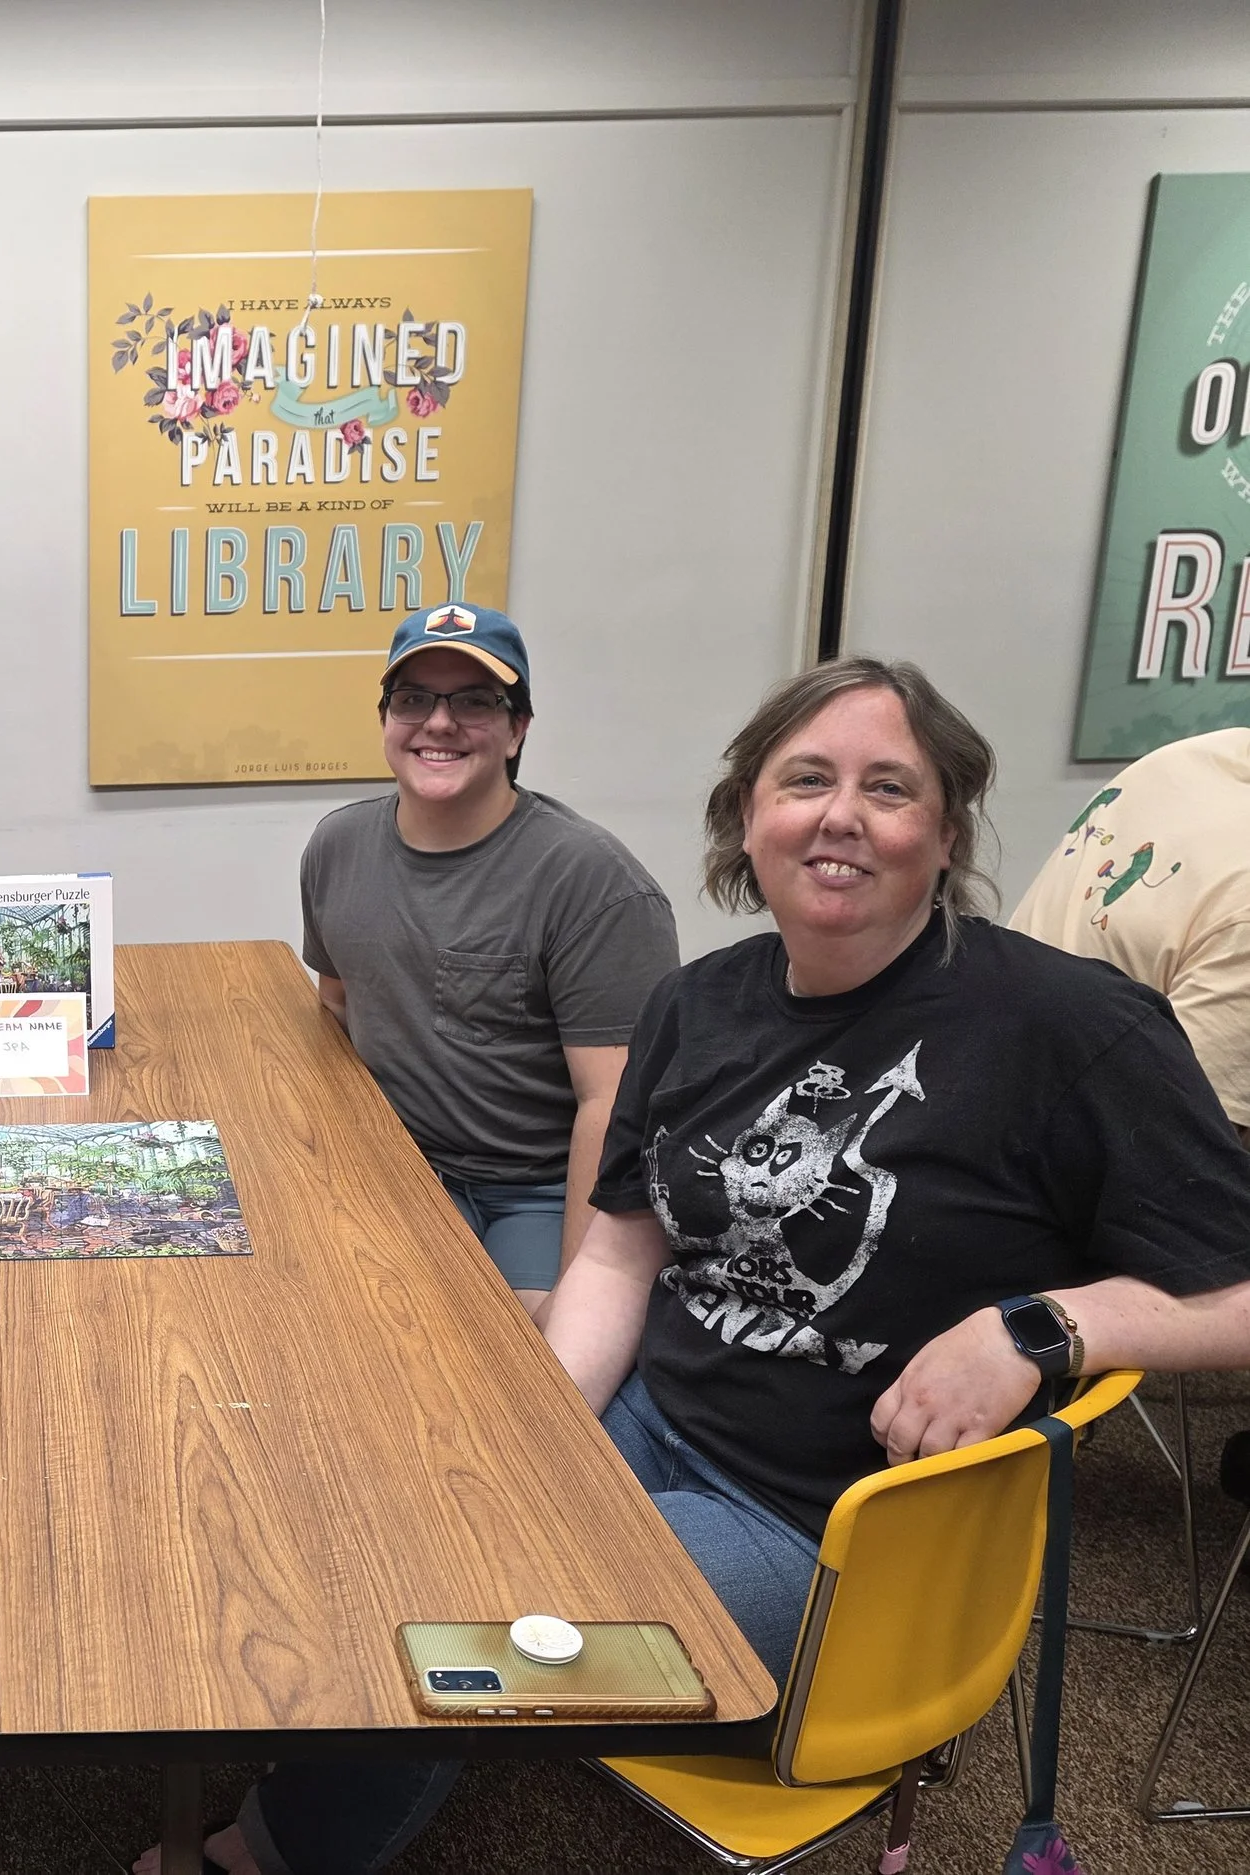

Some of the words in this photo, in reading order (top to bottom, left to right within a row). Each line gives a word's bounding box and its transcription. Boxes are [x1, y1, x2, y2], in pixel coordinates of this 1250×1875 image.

[228, 300, 235, 311] I
[240, 299, 299, 311] HAVE
[165, 321, 467, 390] IMAGINED
[313, 406, 335, 426] that
[180, 426, 443, 487] PARADISE
[206, 502, 261, 513] WILL
[265, 501, 292, 512] BE
[297, 501, 312, 512] A
[316, 500, 367, 511] KIND
[370, 499, 395, 510] OF
[118, 520, 485, 617] LIBRARY
[234, 763, 269, 773] JORGE
[274, 762, 300, 772] LUIS
[305, 761, 349, 772] BORGES
[55, 887, 91, 900] Puzzle
[29, 1022, 63, 1031] NAME
